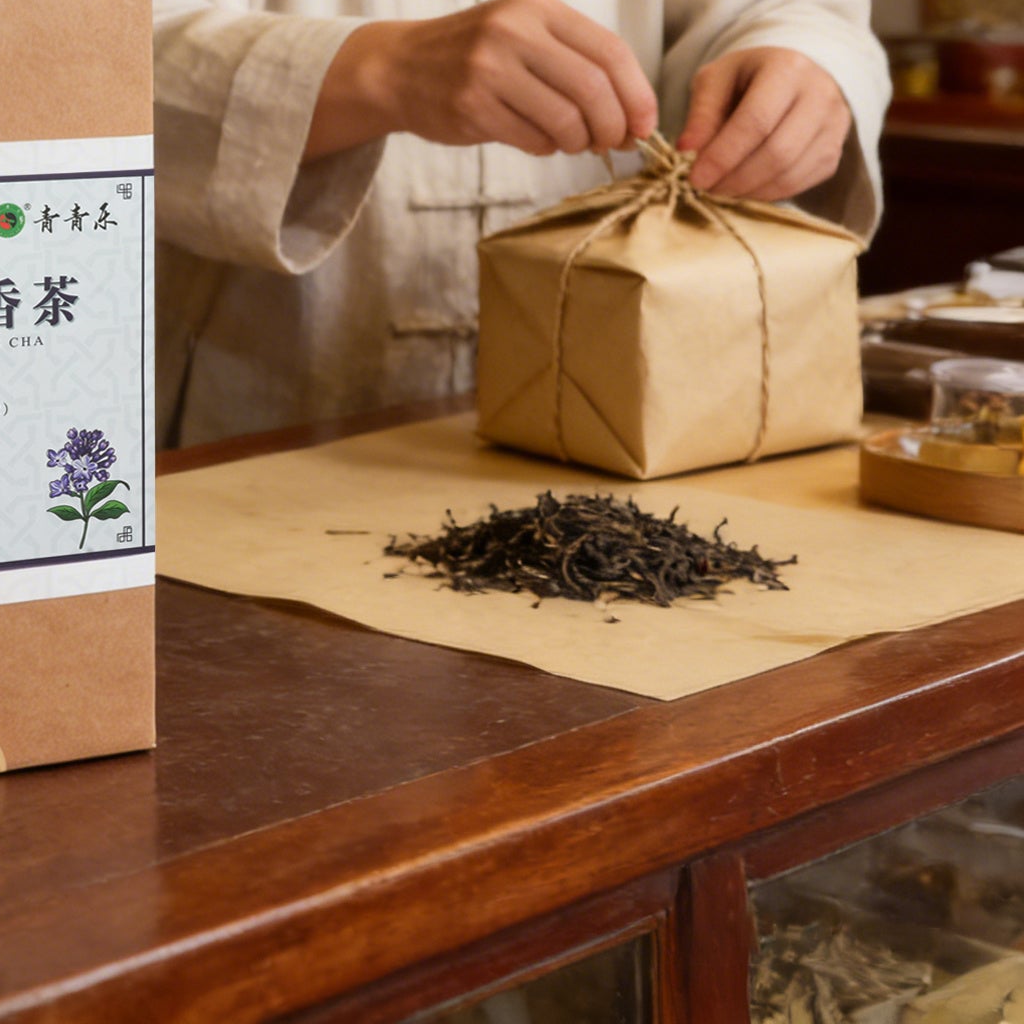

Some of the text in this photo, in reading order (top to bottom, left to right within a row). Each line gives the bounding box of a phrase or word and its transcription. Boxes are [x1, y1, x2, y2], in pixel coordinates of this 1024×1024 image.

[33, 202, 118, 234] 青青乐
[9, 336, 44, 348] CHA
